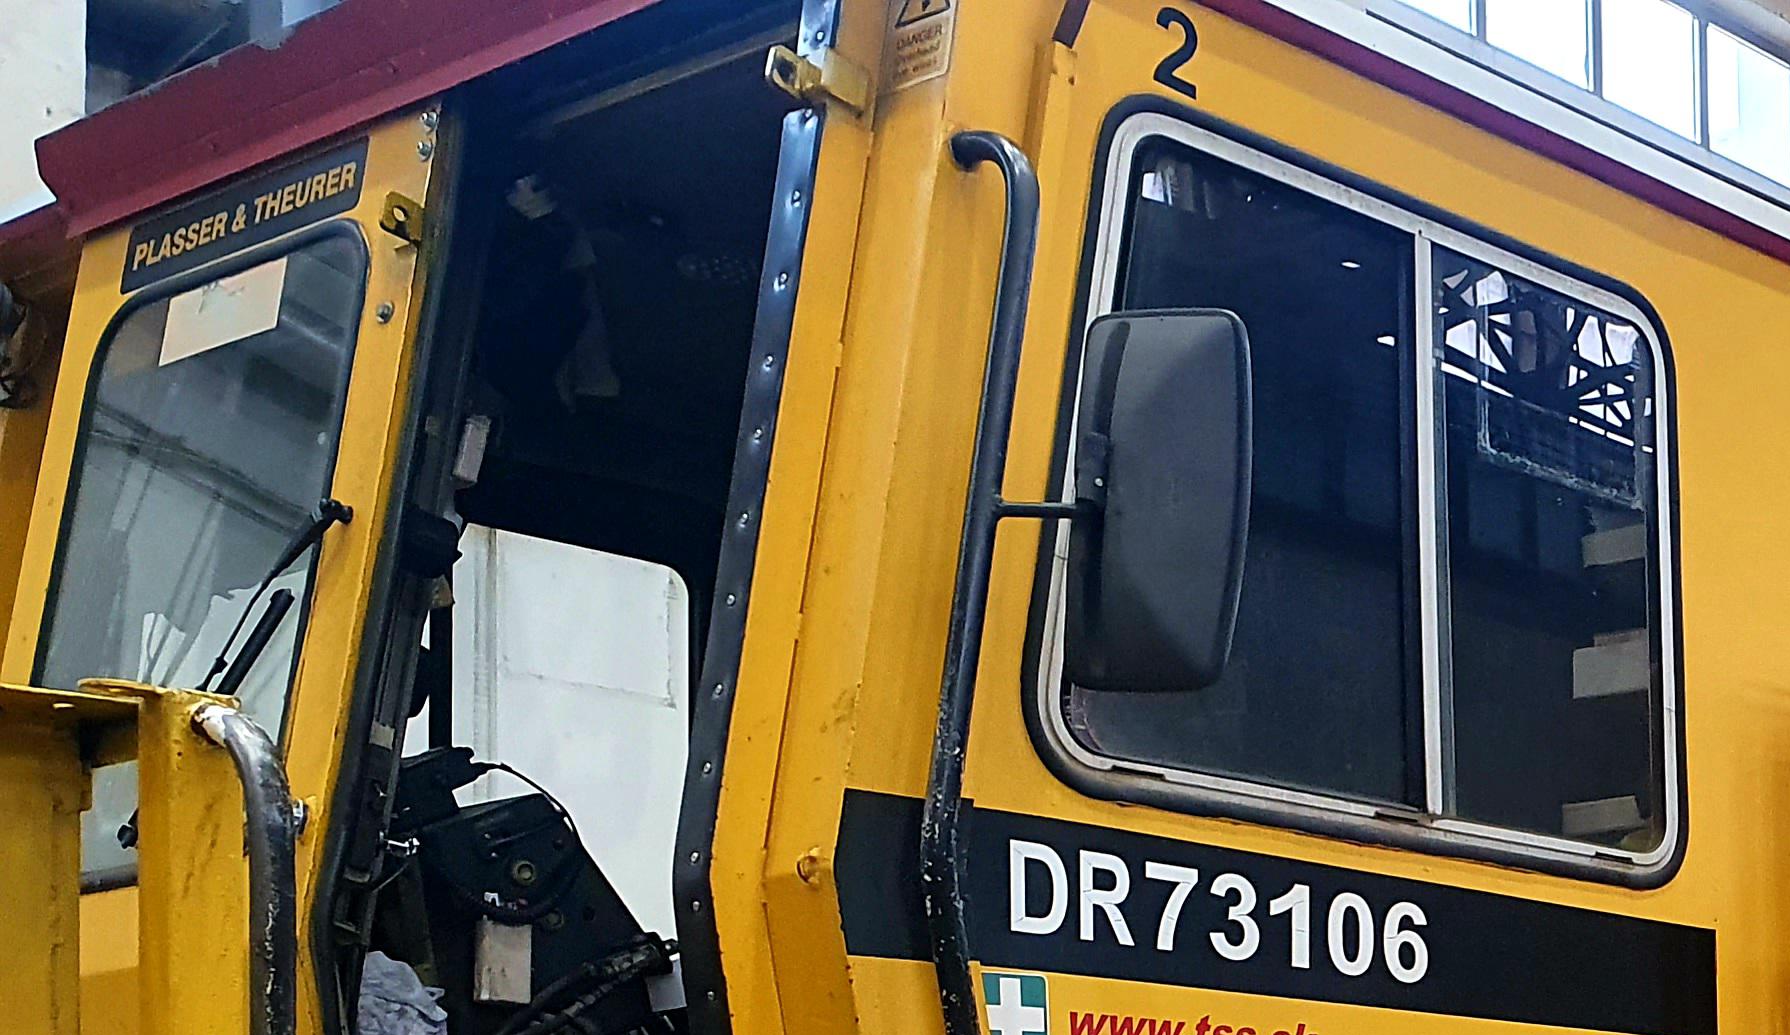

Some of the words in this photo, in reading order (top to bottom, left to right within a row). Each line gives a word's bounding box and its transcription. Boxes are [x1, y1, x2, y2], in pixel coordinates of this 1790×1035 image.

[1153, 7, 1198, 100] 2
[132, 212, 228, 271] PLASSER
[232, 203, 247, 233] &
[254, 161, 357, 225] THEURER
[1010, 839, 1429, 984] DR73106
